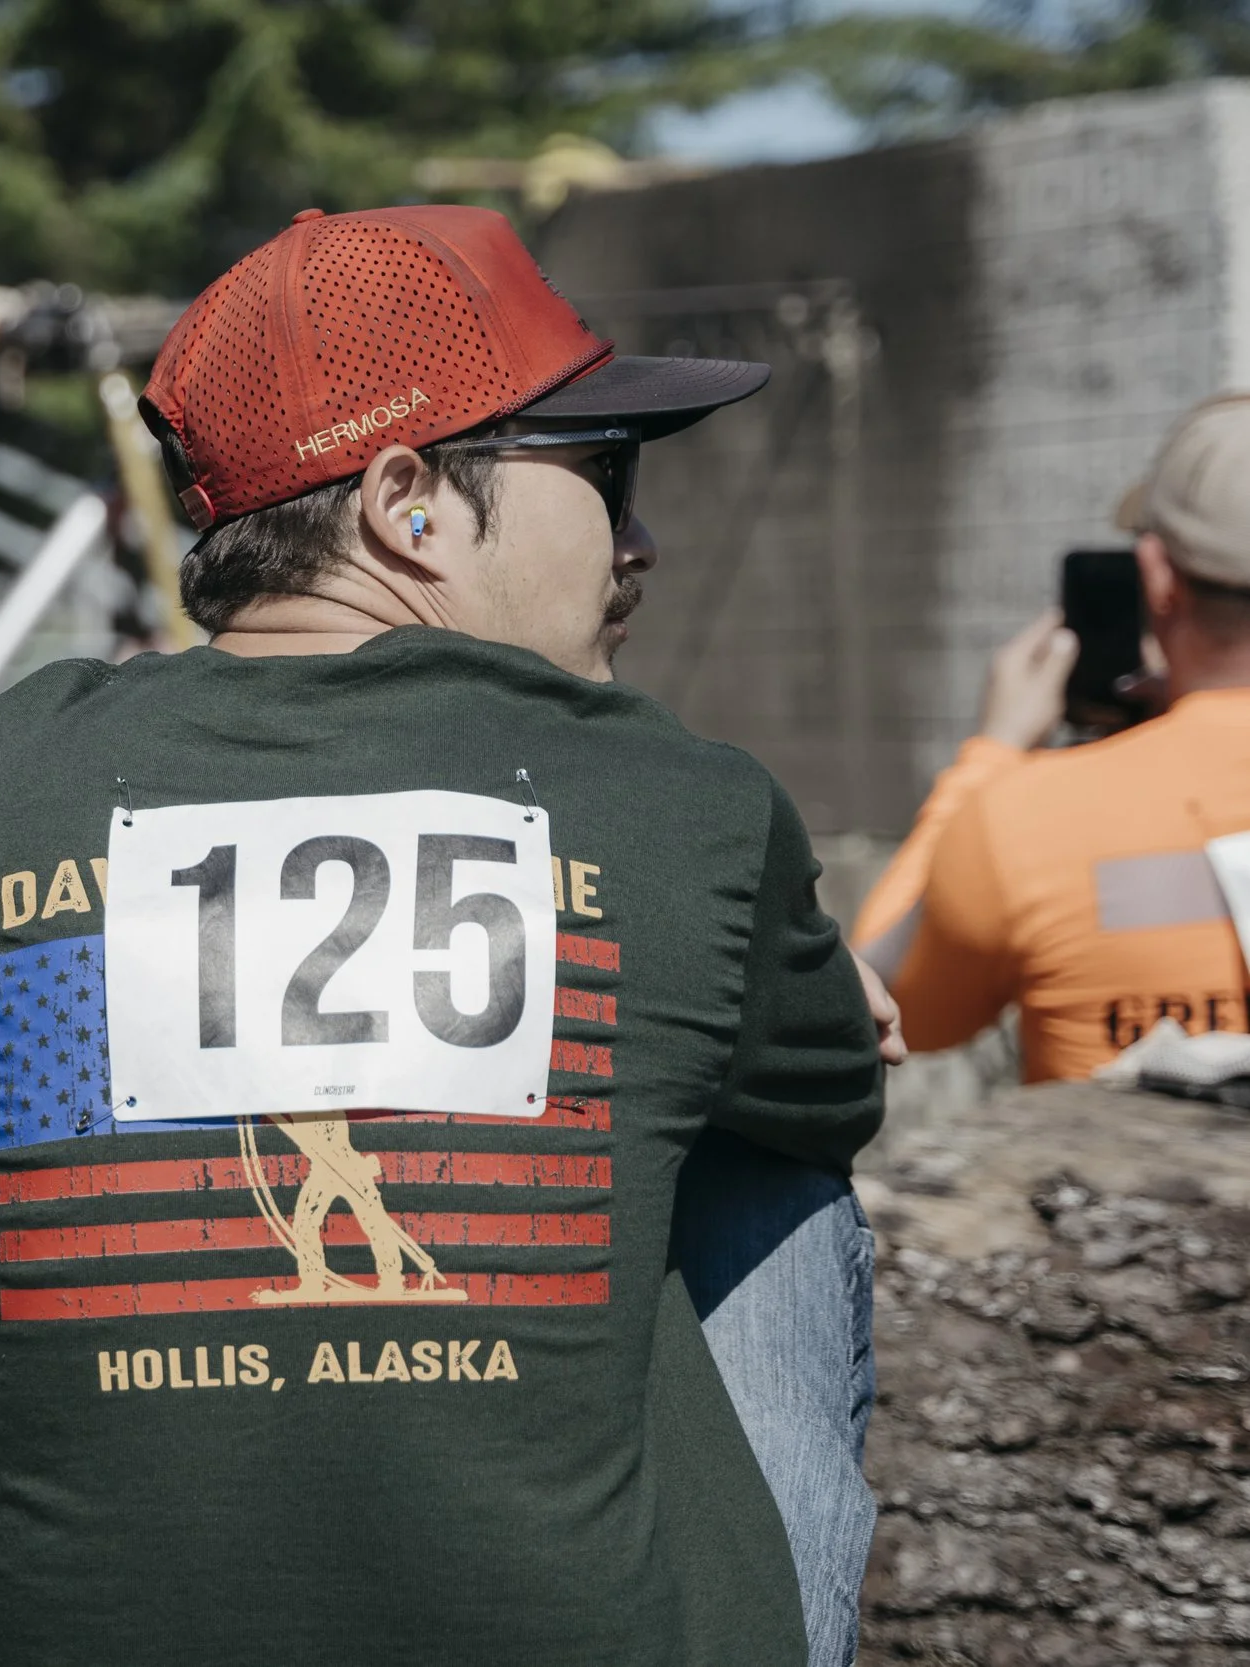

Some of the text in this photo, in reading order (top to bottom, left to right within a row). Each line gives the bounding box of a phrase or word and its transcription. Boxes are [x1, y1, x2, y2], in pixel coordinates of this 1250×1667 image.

[295, 387, 431, 461] HERMOSA
[170, 833, 527, 1049] 125
[98, 1339, 520, 1392] HOLLIS, ALASKA
